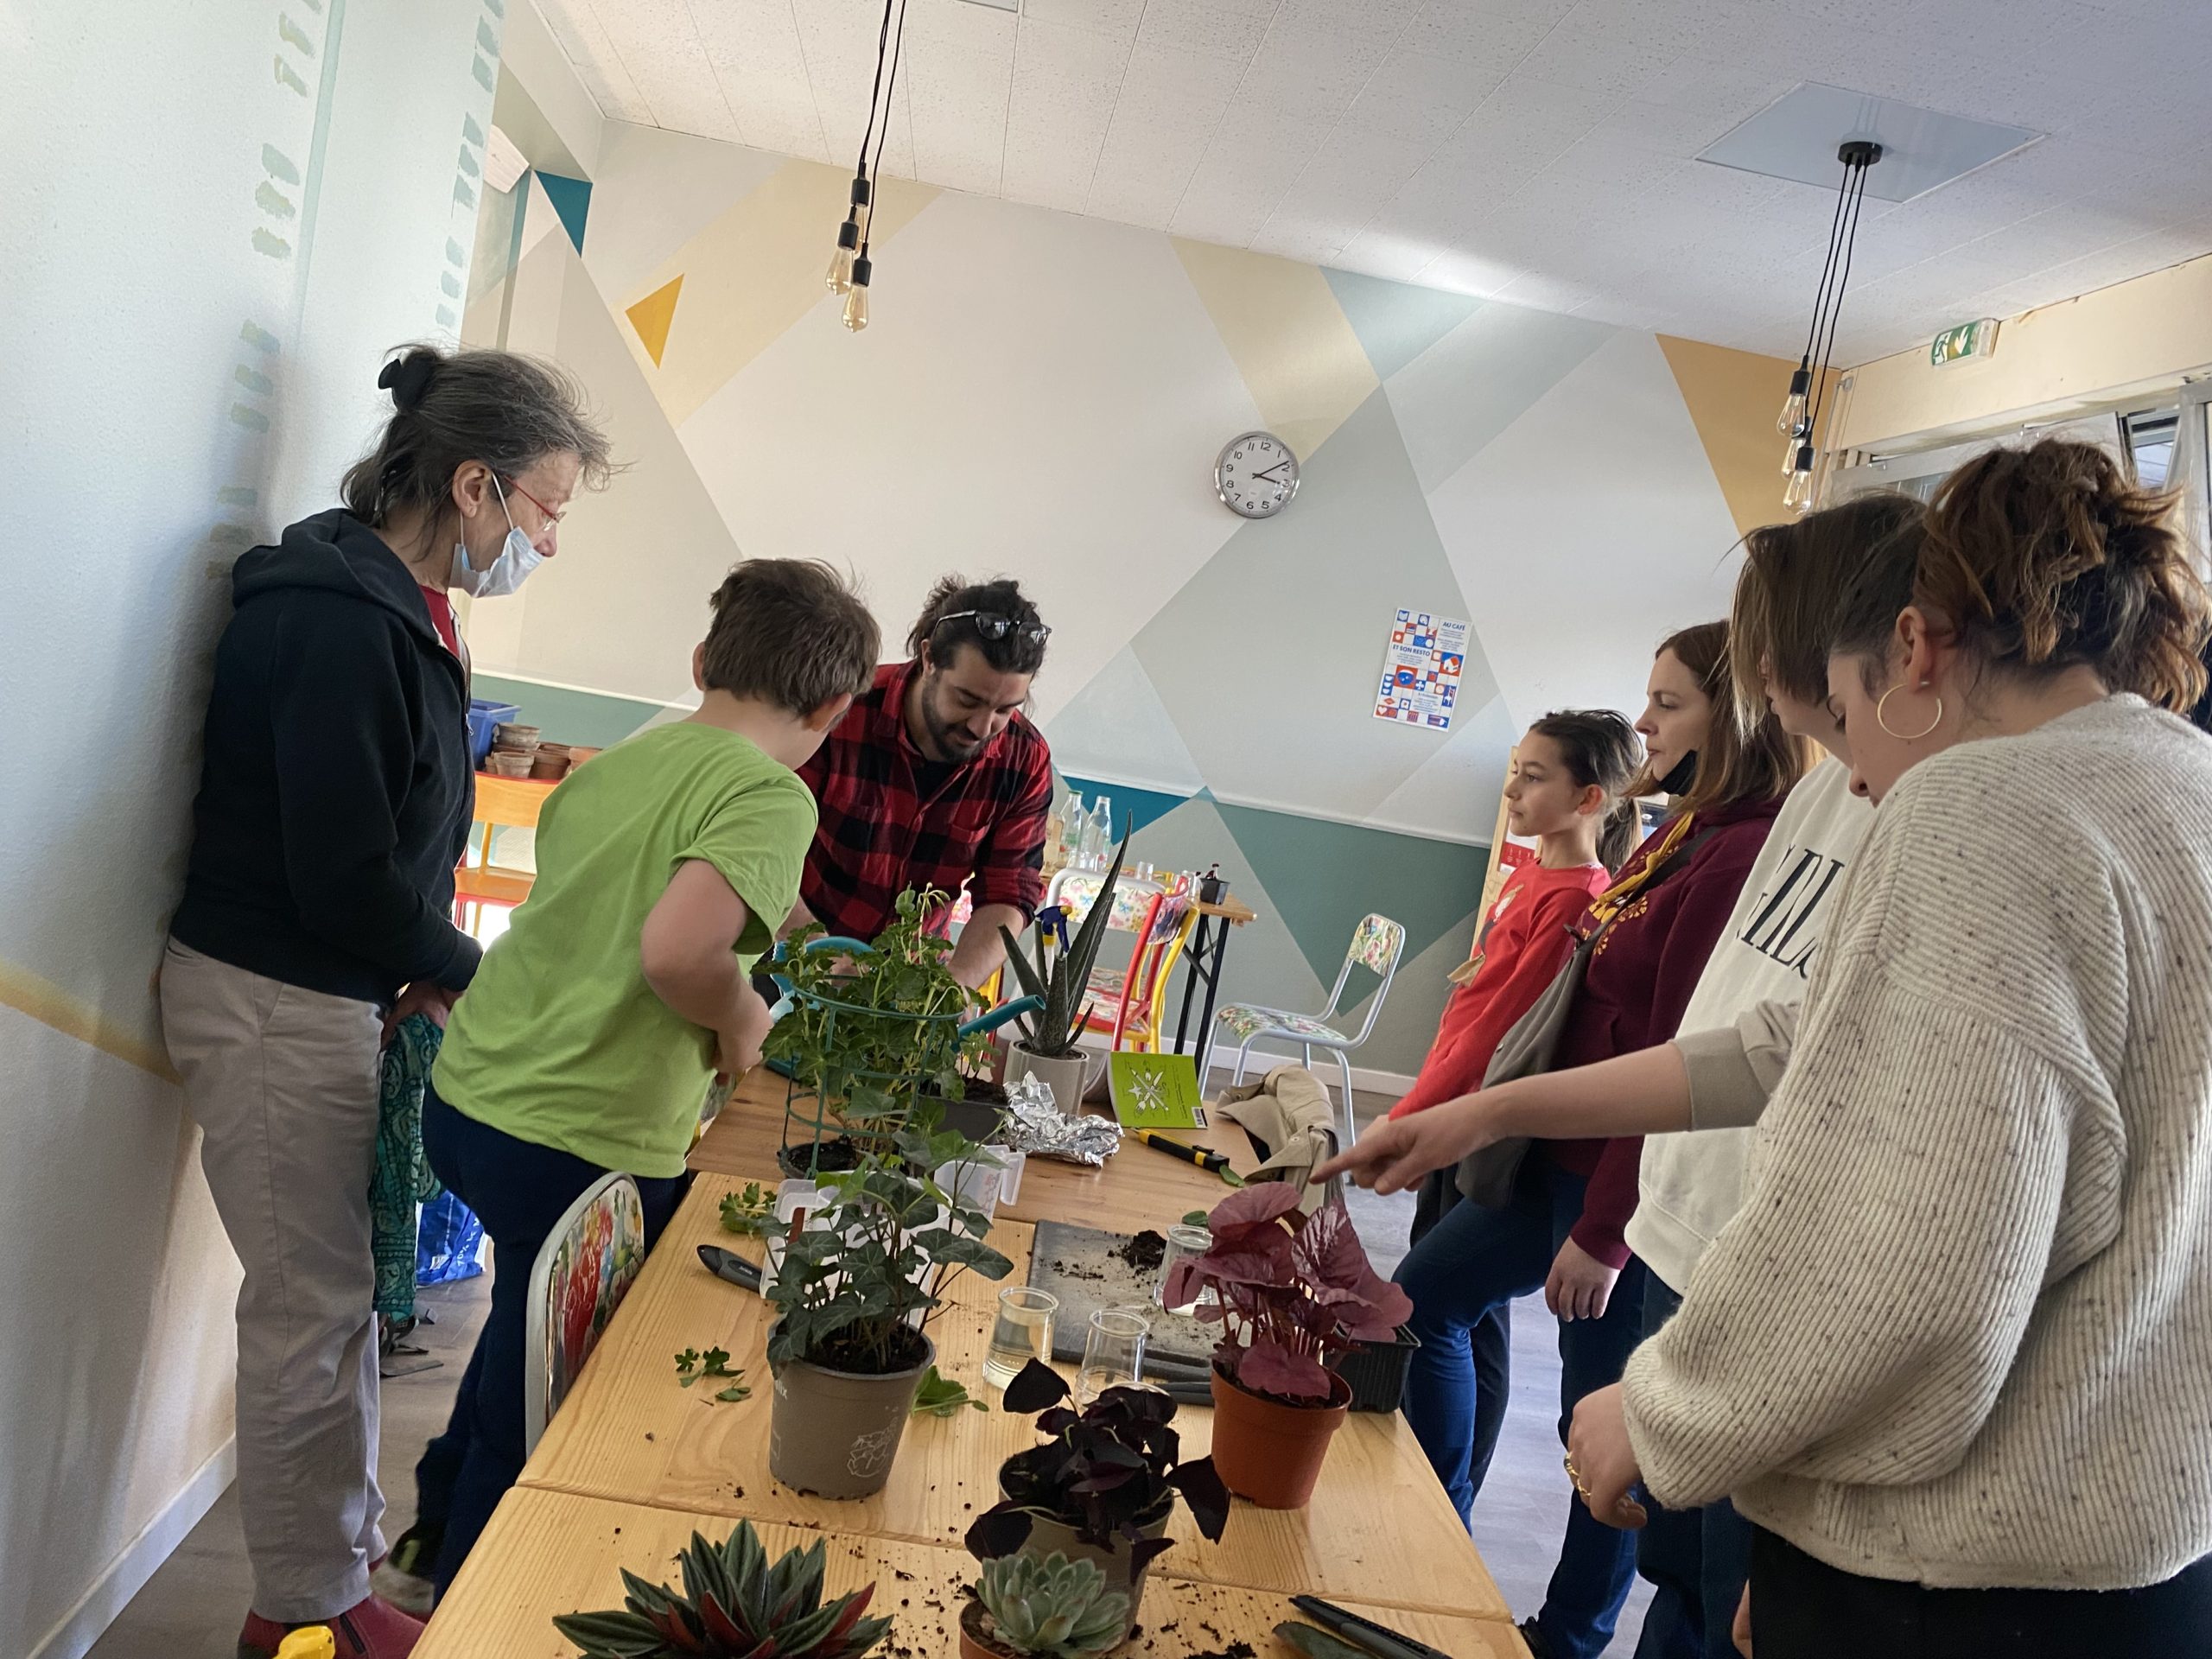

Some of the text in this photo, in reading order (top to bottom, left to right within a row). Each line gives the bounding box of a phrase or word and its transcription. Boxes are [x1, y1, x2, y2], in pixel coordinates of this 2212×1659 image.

[1248, 442, 1255, 451] 11
[1260, 442, 1271, 451] 12
[1234, 451, 1243, 460] 10
[1281, 463, 1290, 472] 2
[1282, 479, 1290, 488] 3
[1274, 493, 1281, 502] 4
